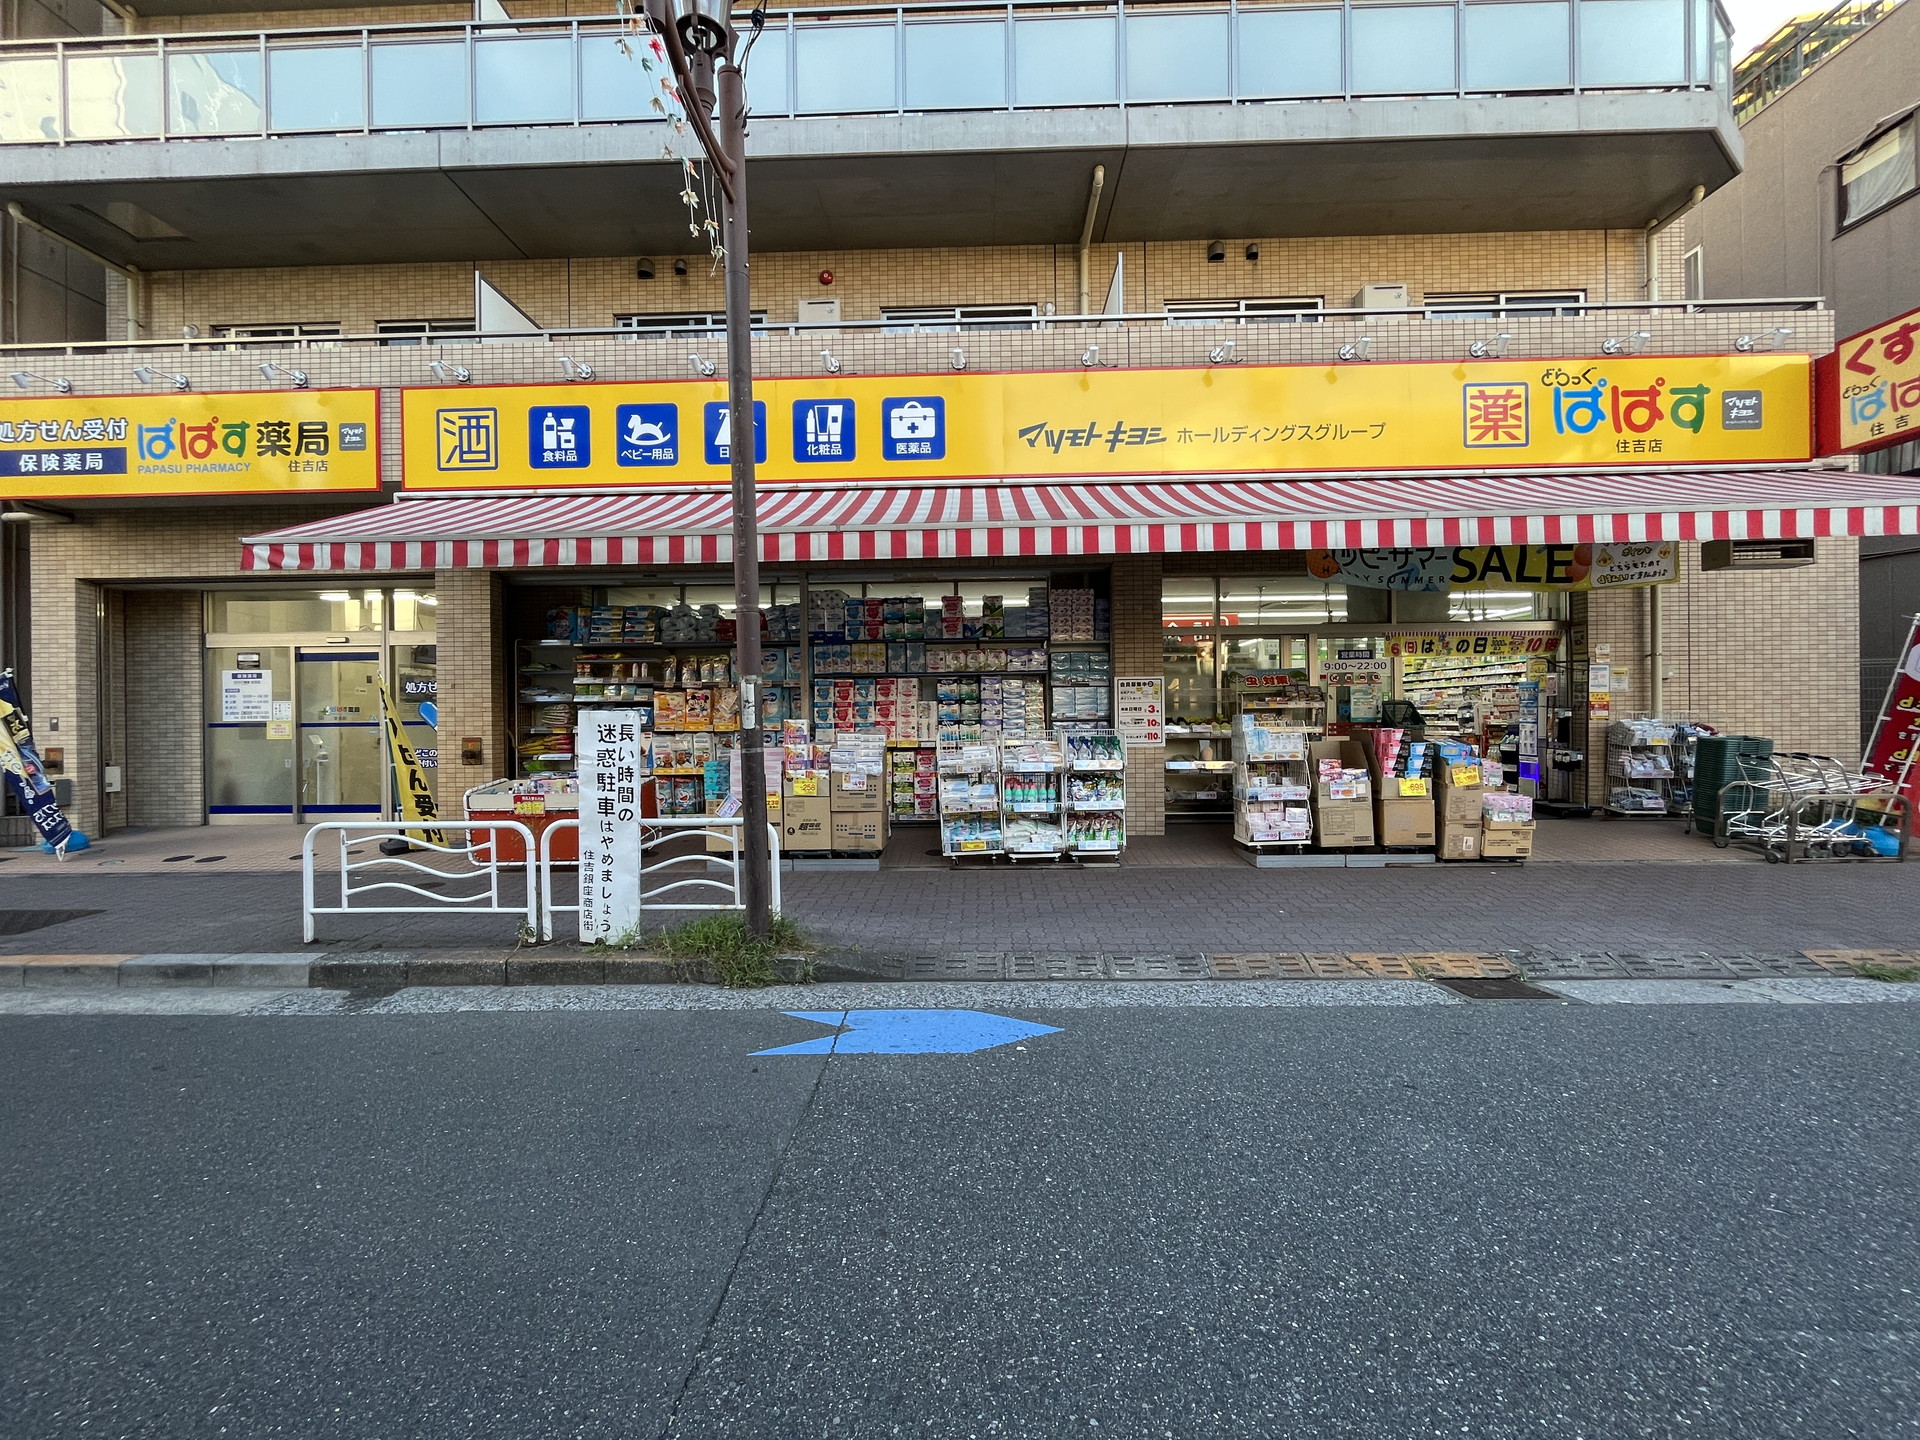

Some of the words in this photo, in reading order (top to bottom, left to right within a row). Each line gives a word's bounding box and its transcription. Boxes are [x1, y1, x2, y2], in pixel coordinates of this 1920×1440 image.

[1541, 367, 1597, 387] どらっぐ
[1469, 389, 1522, 441] 薬
[1553, 377, 1711, 434] ぱぱす
[0, 418, 128, 442] 処方せん受付
[137, 416, 330, 461] ぱぱす薬局
[444, 414, 491, 464] 酒
[1176, 421, 1387, 444] ホールディングスグループ
[542, 450, 578, 462] 食料品
[621, 448, 674, 460] ベビー用品
[806, 443, 843, 456] 化粧品
[895, 442, 932, 455] 医薬品
[1615, 439, 1663, 453] 住吉店
[19, 452, 104, 472] 保険薬局
[137, 465, 182, 475] PAPASU
[186, 463, 251, 474] PHARMACY
[288, 460, 329, 473] 住吉店
[1322, 566, 1370, 582] HAY
[1449, 545, 1574, 583] SALE
[617, 723, 635, 822] 長い時間の
[596, 723, 617, 933] 迷惑駐車はやめましょう
[583, 850, 595, 932] 住吉銀座商店街
